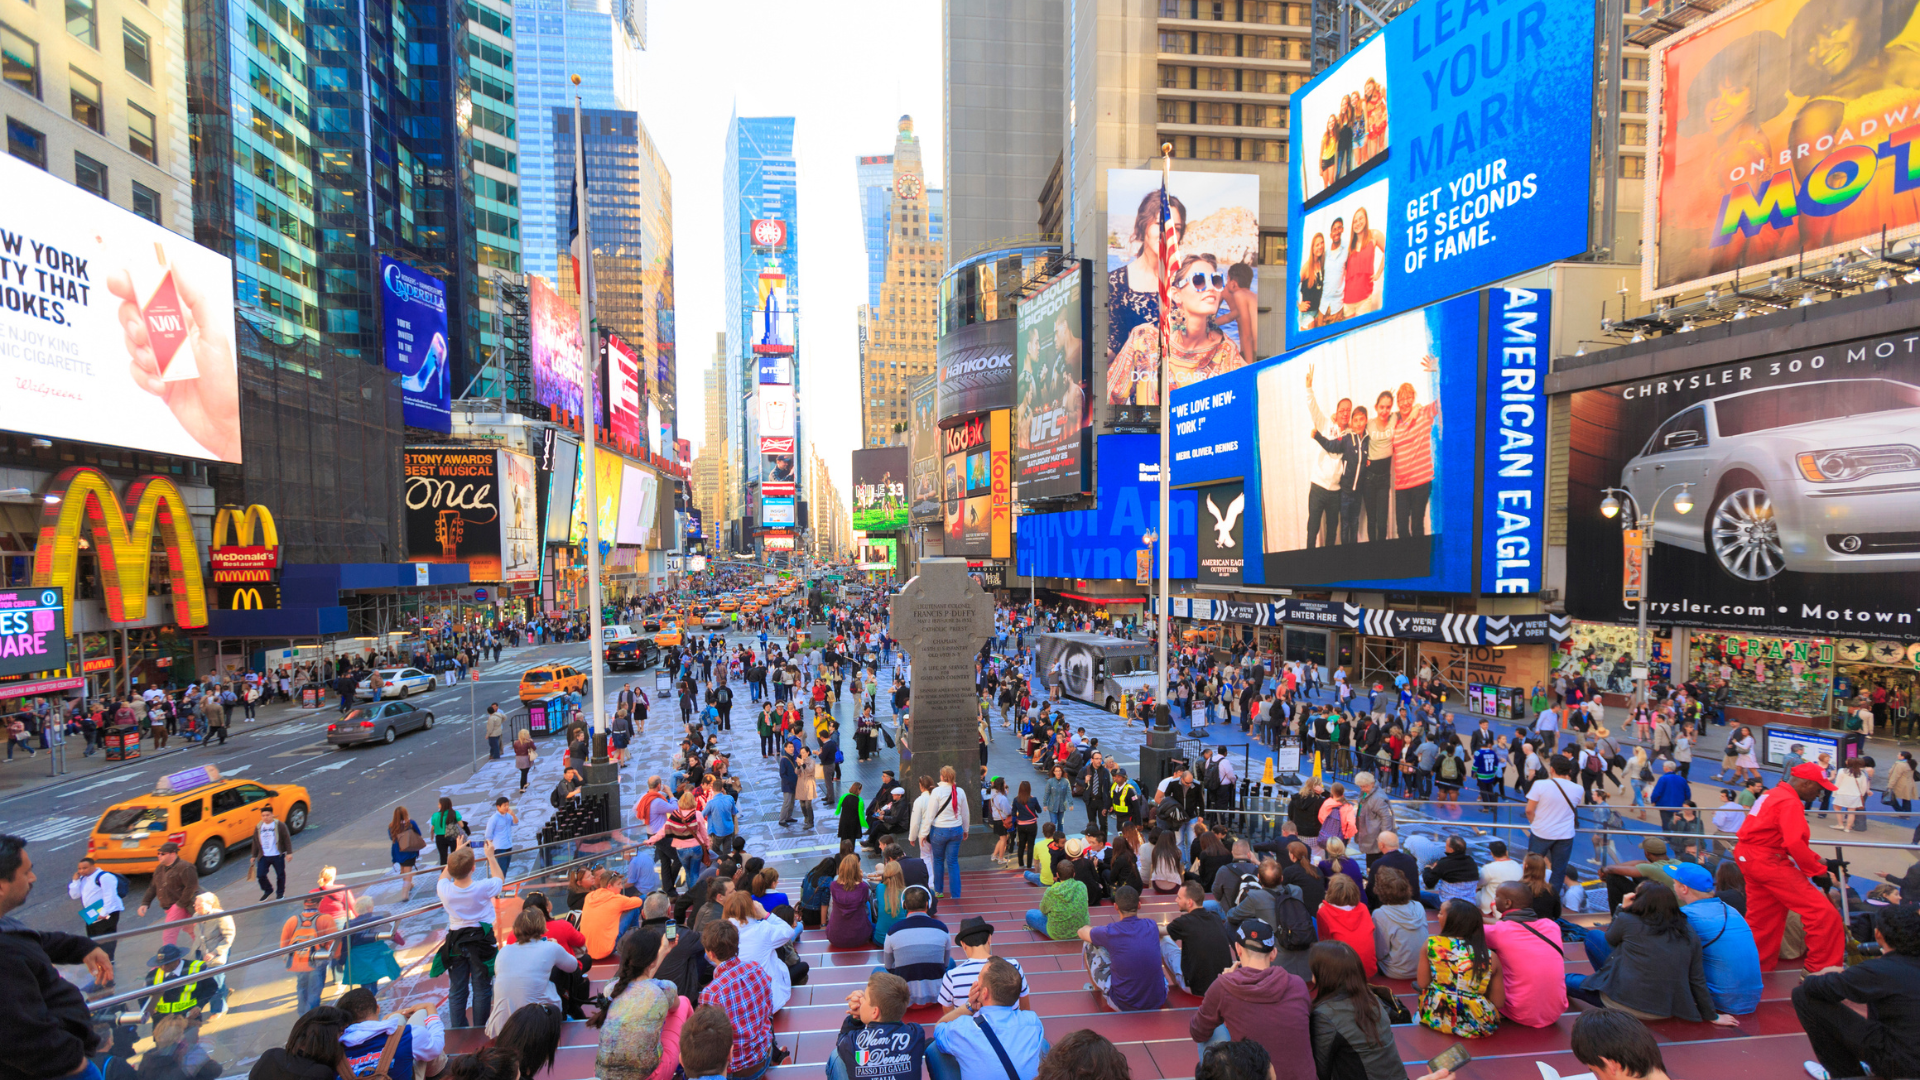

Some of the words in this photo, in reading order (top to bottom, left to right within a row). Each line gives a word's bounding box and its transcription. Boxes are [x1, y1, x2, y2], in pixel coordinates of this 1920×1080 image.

[1422, 1, 1547, 112] YOUR
[1409, 69, 1545, 184] MARK
[1729, 158, 1765, 182] ON
[1407, 187, 1442, 222] GET
[1449, 158, 1507, 202] YOUR
[1406, 222, 1428, 247] 15
[1434, 173, 1538, 236] SECONDS
[1404, 250, 1427, 273] OF
[1434, 221, 1496, 263] FAME.
[30, 238, 90, 282] YORK
[34, 267, 90, 307] THAT
[1018, 270, 1080, 318] VELASQUEZ
[1025, 290, 1070, 331] BIGFOOT
[1071, 286, 1080, 303] 2
[148, 315, 184, 332] NJOY
[8, 325, 45, 347] NJOY
[49, 336, 79, 356] KING
[754, 344, 794, 352] TOSHIBA
[23, 347, 96, 377] CIGARETTE.
[976, 368, 1012, 378] emotion
[1498, 286, 1538, 477] AMERICAN
[1623, 366, 1752, 400] CHRYSLER
[1770, 355, 1825, 376] 300
[1190, 398, 1210, 414] LOVE
[1212, 390, 1236, 407] NEW-
[1030, 407, 1063, 443] UFC
[1176, 419, 1197, 436] YORK
[946, 417, 984, 454] Kodak
[1192, 447, 1214, 459] OLIVIER,
[1215, 441, 1239, 454] RENNES
[411, 454, 443, 465] TONY
[443, 454, 493, 465] AWARDS
[1027, 456, 1050, 468] SATURDAY
[1050, 453, 1061, 462] MAY
[1139, 463, 1160, 472] Bank
[405, 466, 435, 476] BEST
[439, 466, 493, 476] MUSICAL
[1022, 467, 1032, 476] LIVE
[888, 483, 904, 496] 33
[992, 451, 1009, 520] Kodak
[1495, 490, 1532, 594] EAGLE
[212, 552, 275, 562] McDonald's
[14, 600, 37, 608] CENTER
[1291, 611, 1315, 620] ENTER
[1316, 612, 1337, 622] HERE
[1412, 617, 1437, 627] WE'RE
[1801, 603, 1912, 624] Motown
[0, 611, 29, 635] ES
[1411, 625, 1434, 634] OPEN
[1525, 620, 1548, 629] WE'RE
[1786, 626, 1816, 634] Recordings
[1525, 629, 1545, 637] OPEN
[0, 632, 48, 659] ARE
[1450, 645, 1504, 663] SHOP
[1727, 637, 1835, 663] GRAND
[1450, 669, 1503, 686] NOW
[25, 685, 37, 694] AND
[1484, 759, 1494, 772] 17
[891, 1033, 911, 1051] 79
[867, 1048, 911, 1066] Denim
[858, 1067, 878, 1076] PASSO
[879, 1066, 887, 1075] DI
[888, 1063, 909, 1073] GAVIA
